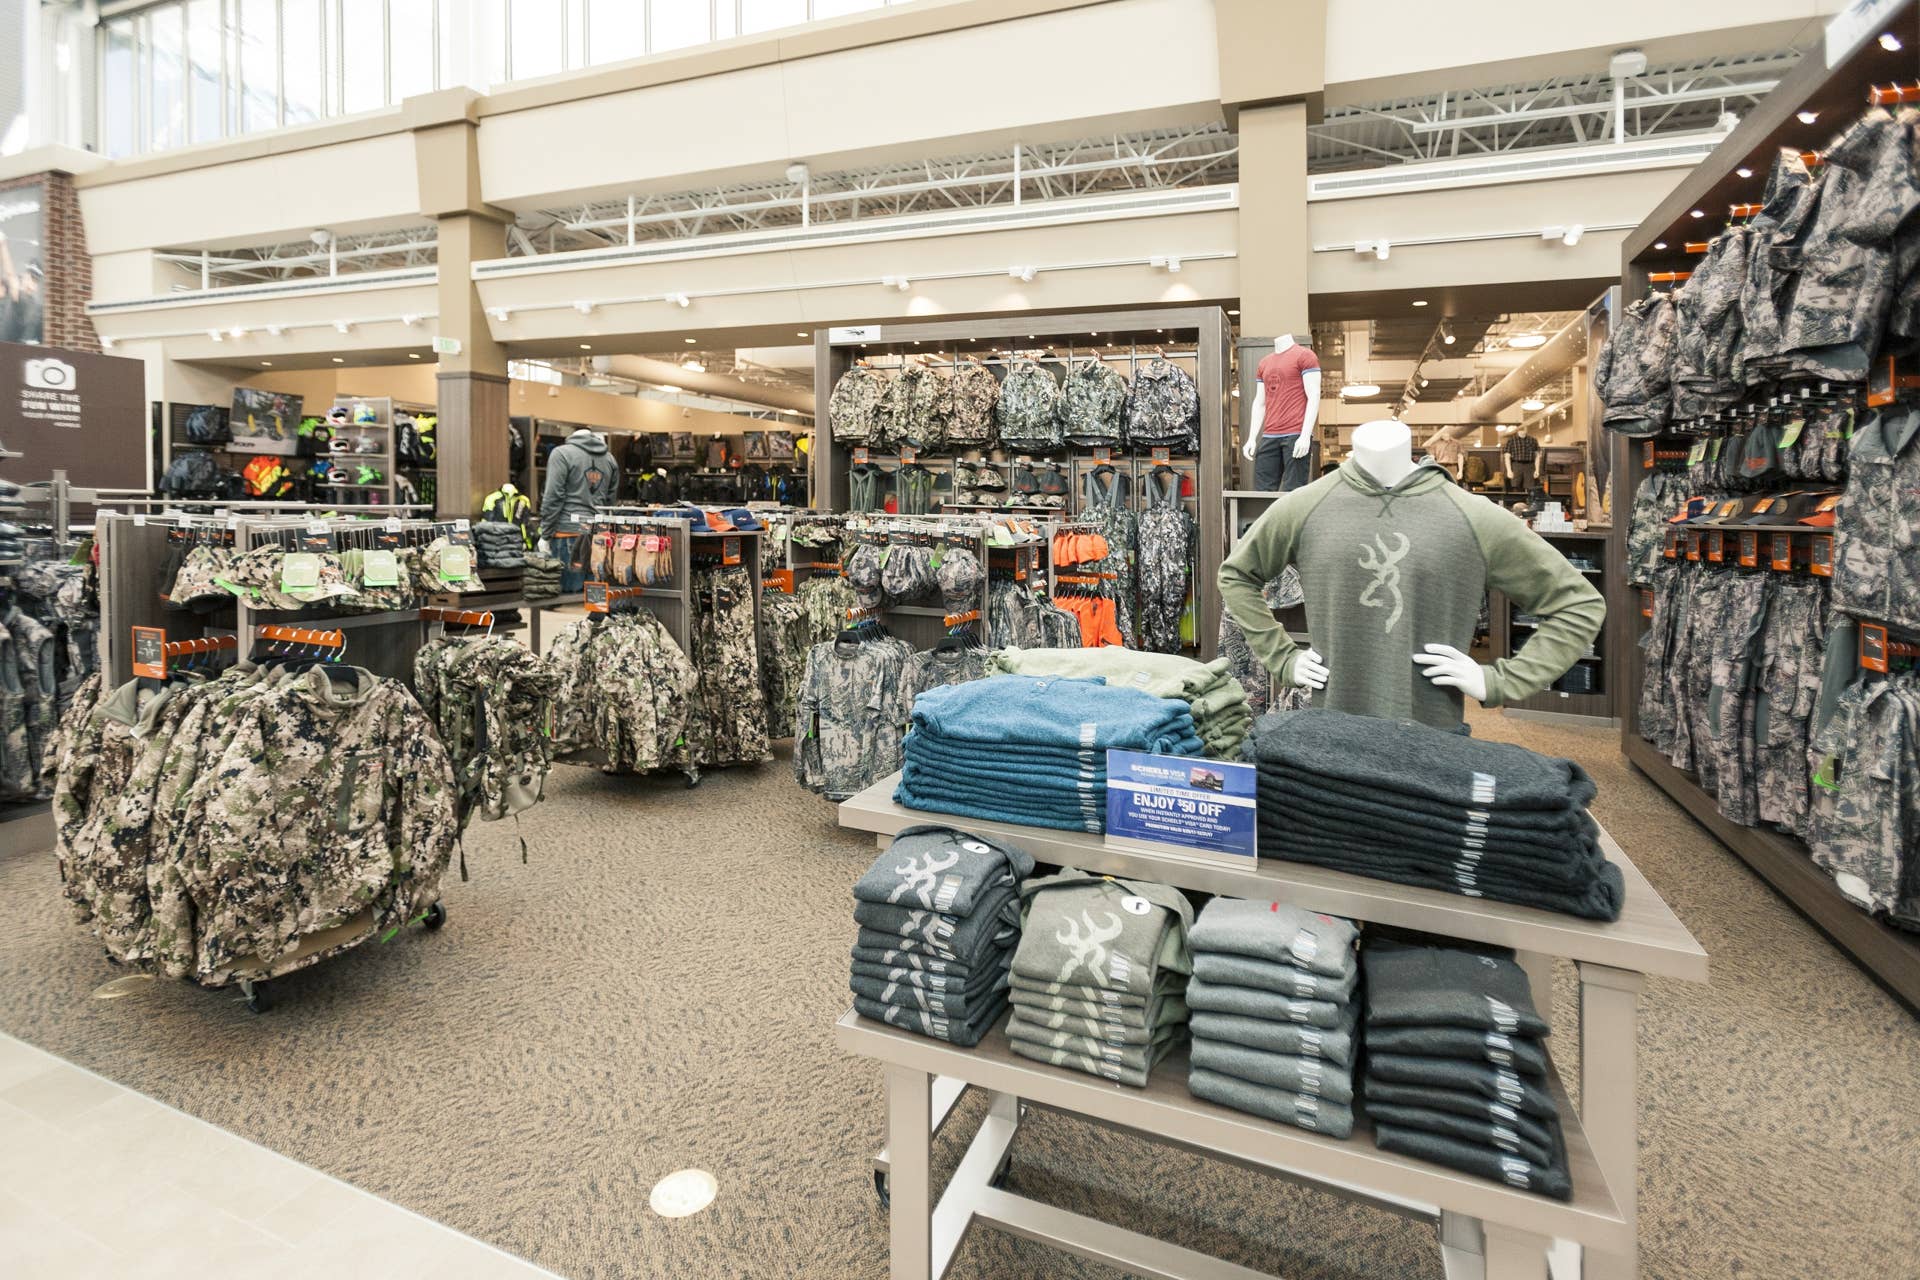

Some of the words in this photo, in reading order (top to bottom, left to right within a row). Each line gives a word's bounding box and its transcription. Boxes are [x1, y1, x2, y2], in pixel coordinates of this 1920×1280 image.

[1133, 792, 1176, 810] ENJOY
[1177, 799, 1196, 813] $50
[1192, 792, 1211, 800] OFFER
